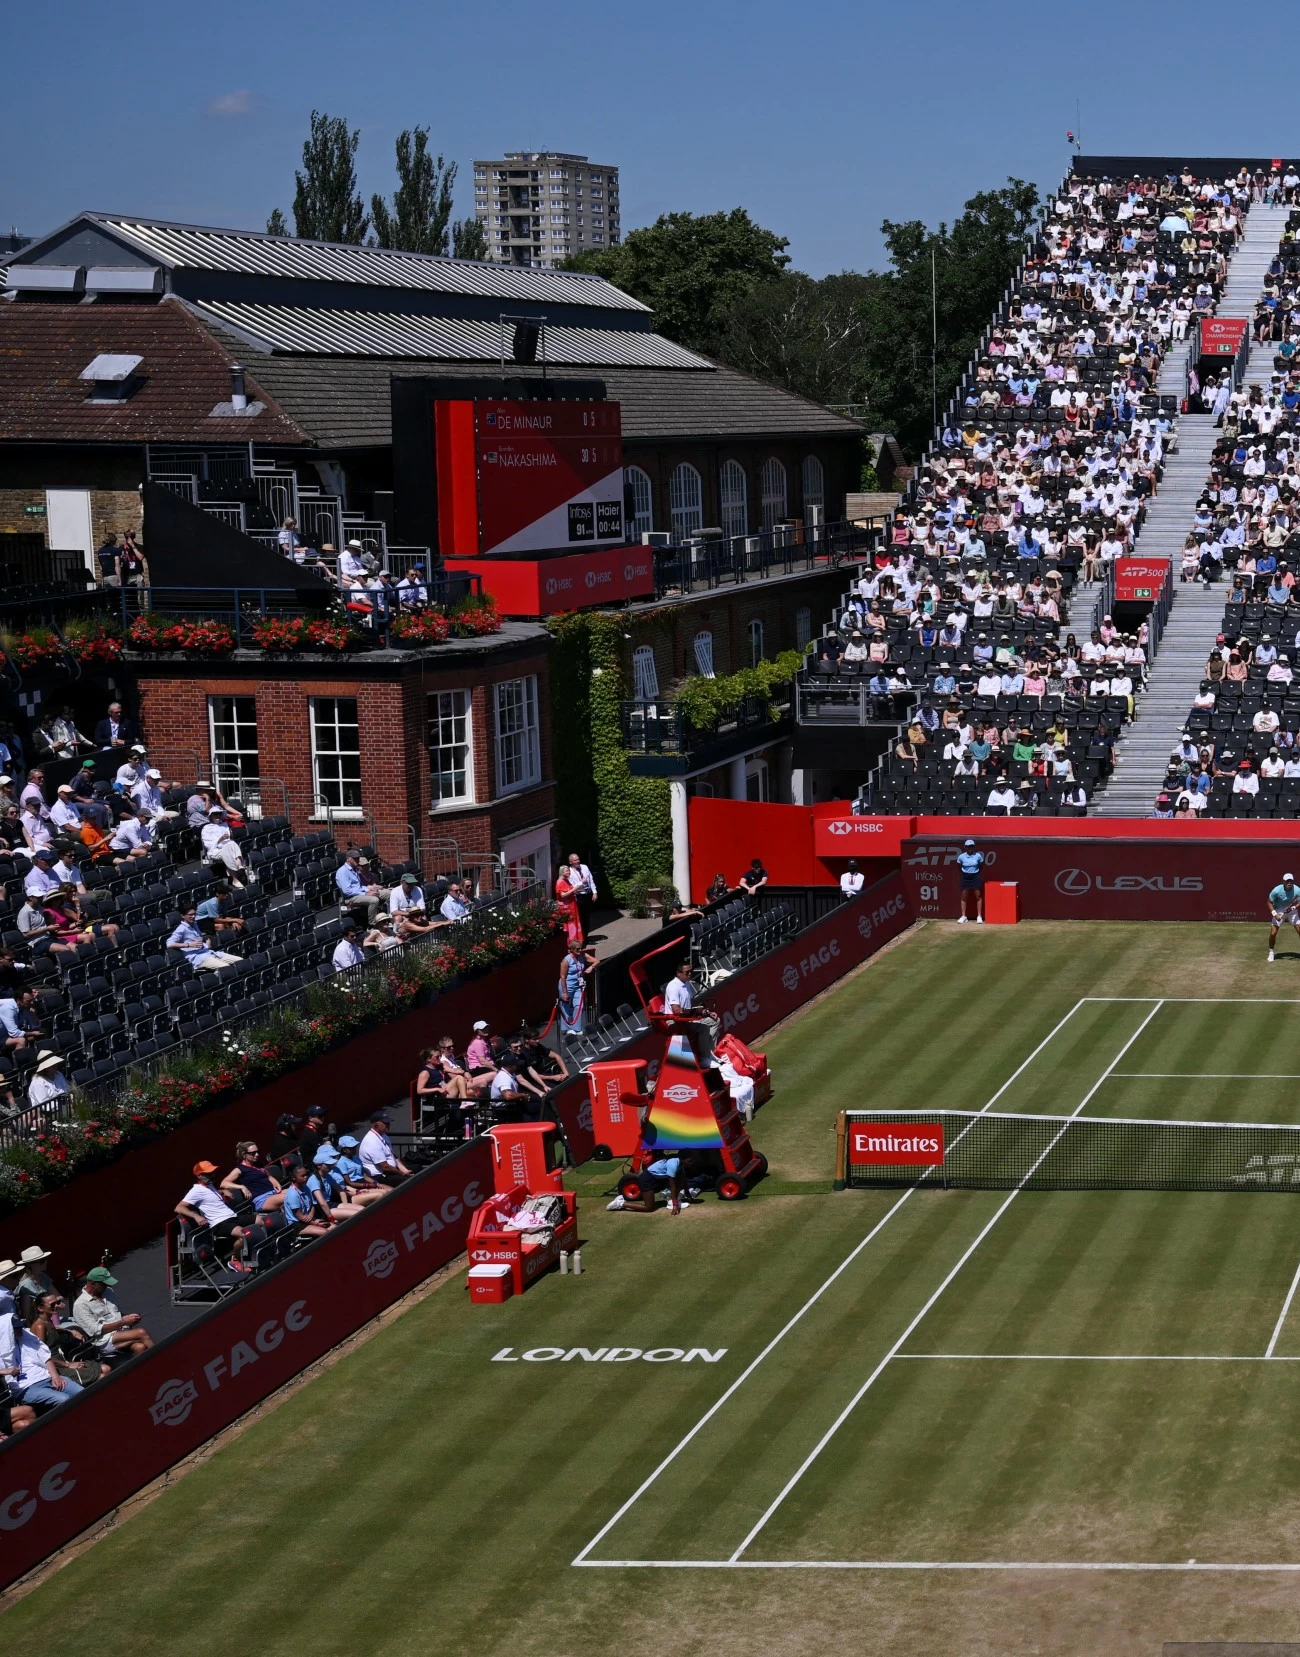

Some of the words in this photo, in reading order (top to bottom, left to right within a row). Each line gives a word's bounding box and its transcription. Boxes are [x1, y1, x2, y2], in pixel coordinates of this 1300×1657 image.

[498, 416, 511, 429] DE
[514, 416, 552, 429] MINAUR
[583, 412, 588, 426] 0
[591, 411, 596, 426] 5
[499, 453, 558, 467] NAKASHIMA
[581, 448, 589, 463] 30
[592, 448, 597, 462] 5
[570, 507, 592, 519] Infosys
[598, 504, 620, 516] Haier
[576, 523, 586, 536] 91
[598, 520, 620, 532] 00:44
[597, 572, 612, 584] HSBC
[635, 565, 648, 576] HSBC
[1121, 567, 1148, 576] ATP
[559, 578, 573, 590] HSBC
[854, 823, 883, 833] HSBC
[915, 871, 943, 882] Infosys
[1096, 876, 1203, 891] LEXUS
[919, 886, 938, 901] 91
[872, 894, 905, 927] FAGE
[800, 939, 840, 976] FAGE
[720, 993, 760, 1031] AGE
[606, 1078, 620, 1112] BRITA
[855, 1134, 939, 1152] Emirates
[510, 1143, 525, 1179] BRITA
[402, 1181, 484, 1252] FAGE
[367, 1246, 395, 1272] FAGE
[493, 1251, 518, 1259] HSBC
[204, 1300, 312, 1391] FAGE
[490, 1347, 729, 1362] LONDON
[155, 1387, 193, 1418] FAGE
[0, 1461, 76, 1531] GE
